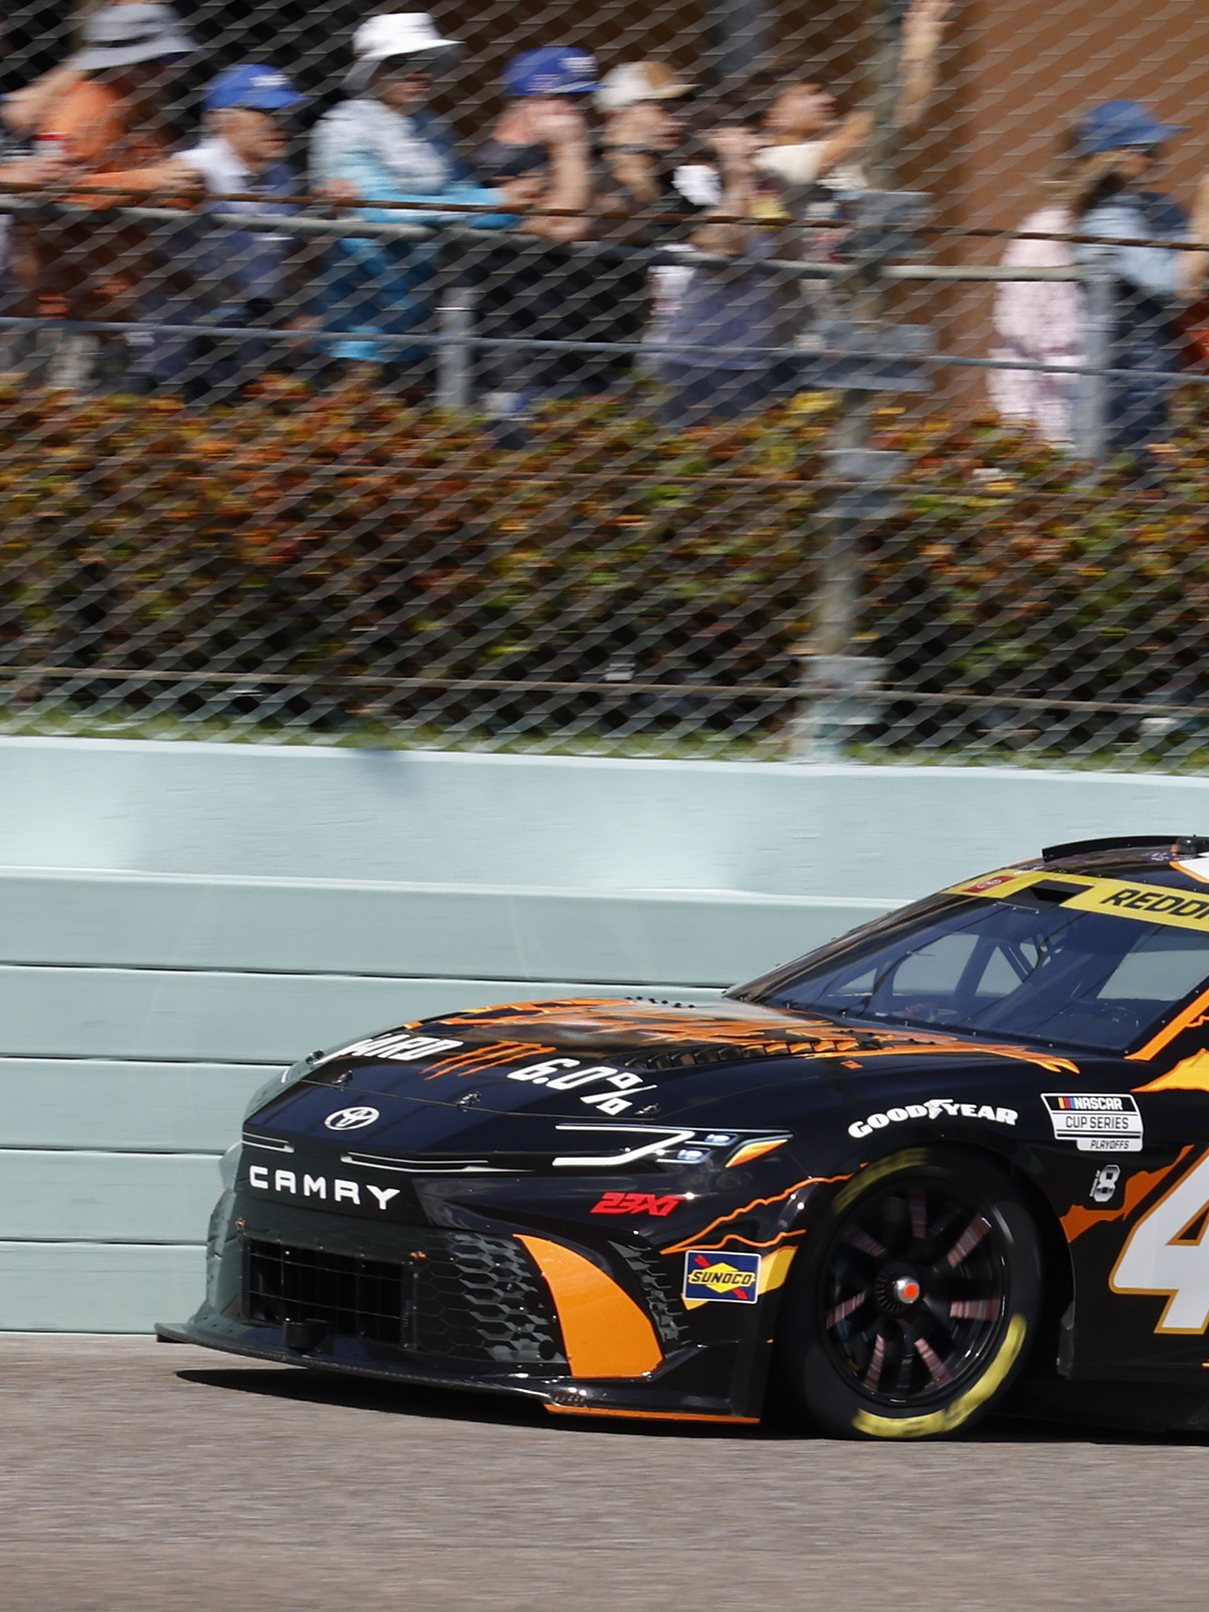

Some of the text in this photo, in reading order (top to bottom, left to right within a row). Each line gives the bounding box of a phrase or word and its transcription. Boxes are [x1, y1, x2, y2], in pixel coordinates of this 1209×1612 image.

[507, 1058, 658, 1116] 6.0%
[1073, 1097, 1124, 1111] NASCAR
[848, 1099, 1018, 1138] GOODYEAR
[1065, 1116, 1130, 1130] CUP SERIES
[1090, 1140, 1130, 1150] PLAYOFFS
[250, 1165, 401, 1210] CAMRY
[691, 1270, 753, 1286] SUNOCO
